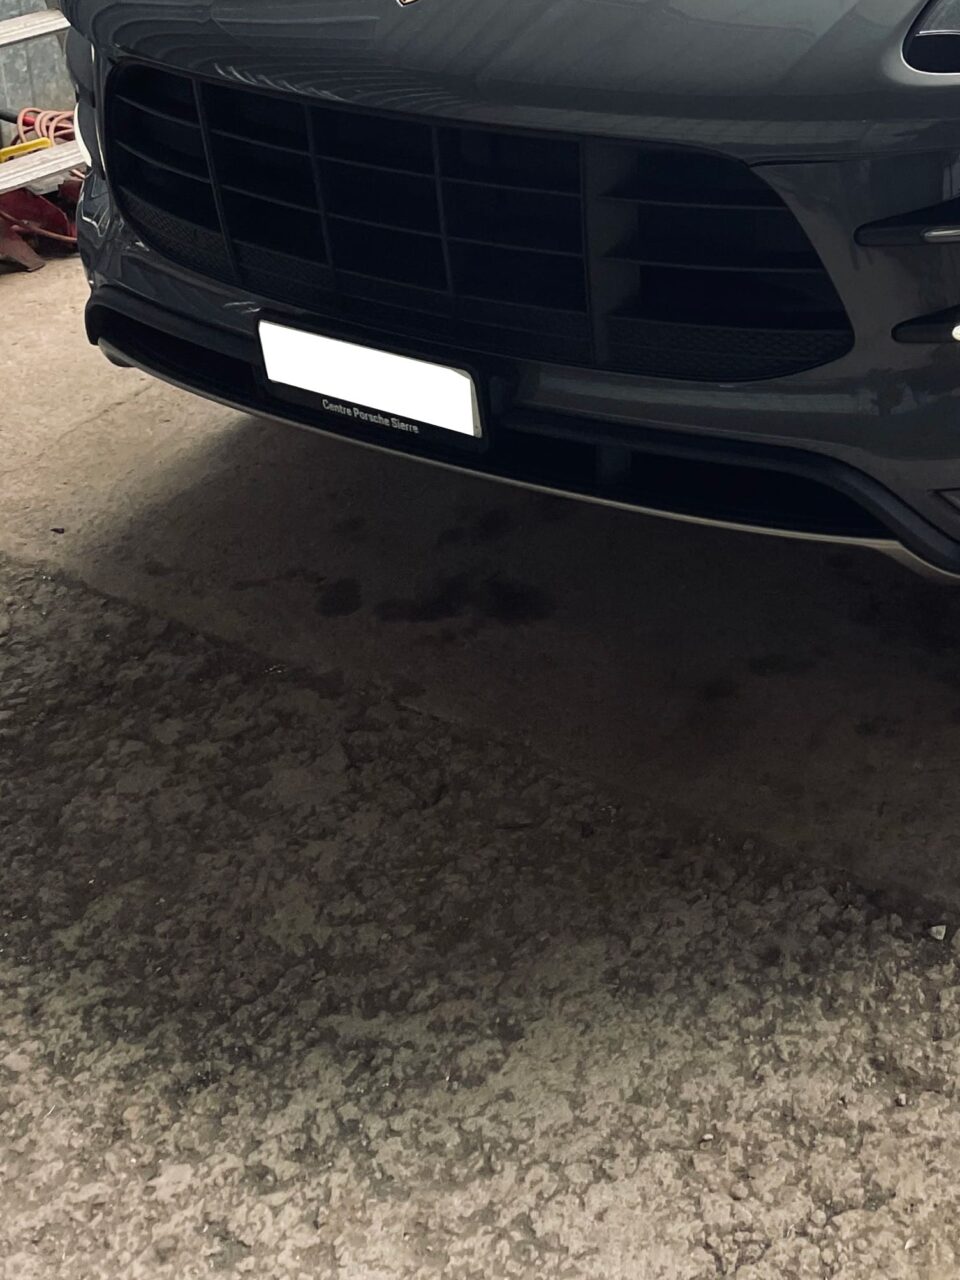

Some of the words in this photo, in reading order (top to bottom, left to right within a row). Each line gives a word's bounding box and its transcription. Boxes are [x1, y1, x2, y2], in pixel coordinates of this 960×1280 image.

[322, 399, 352, 416] Centre
[353, 407, 390, 426] Porsche
[390, 418, 419, 434] Sierre
